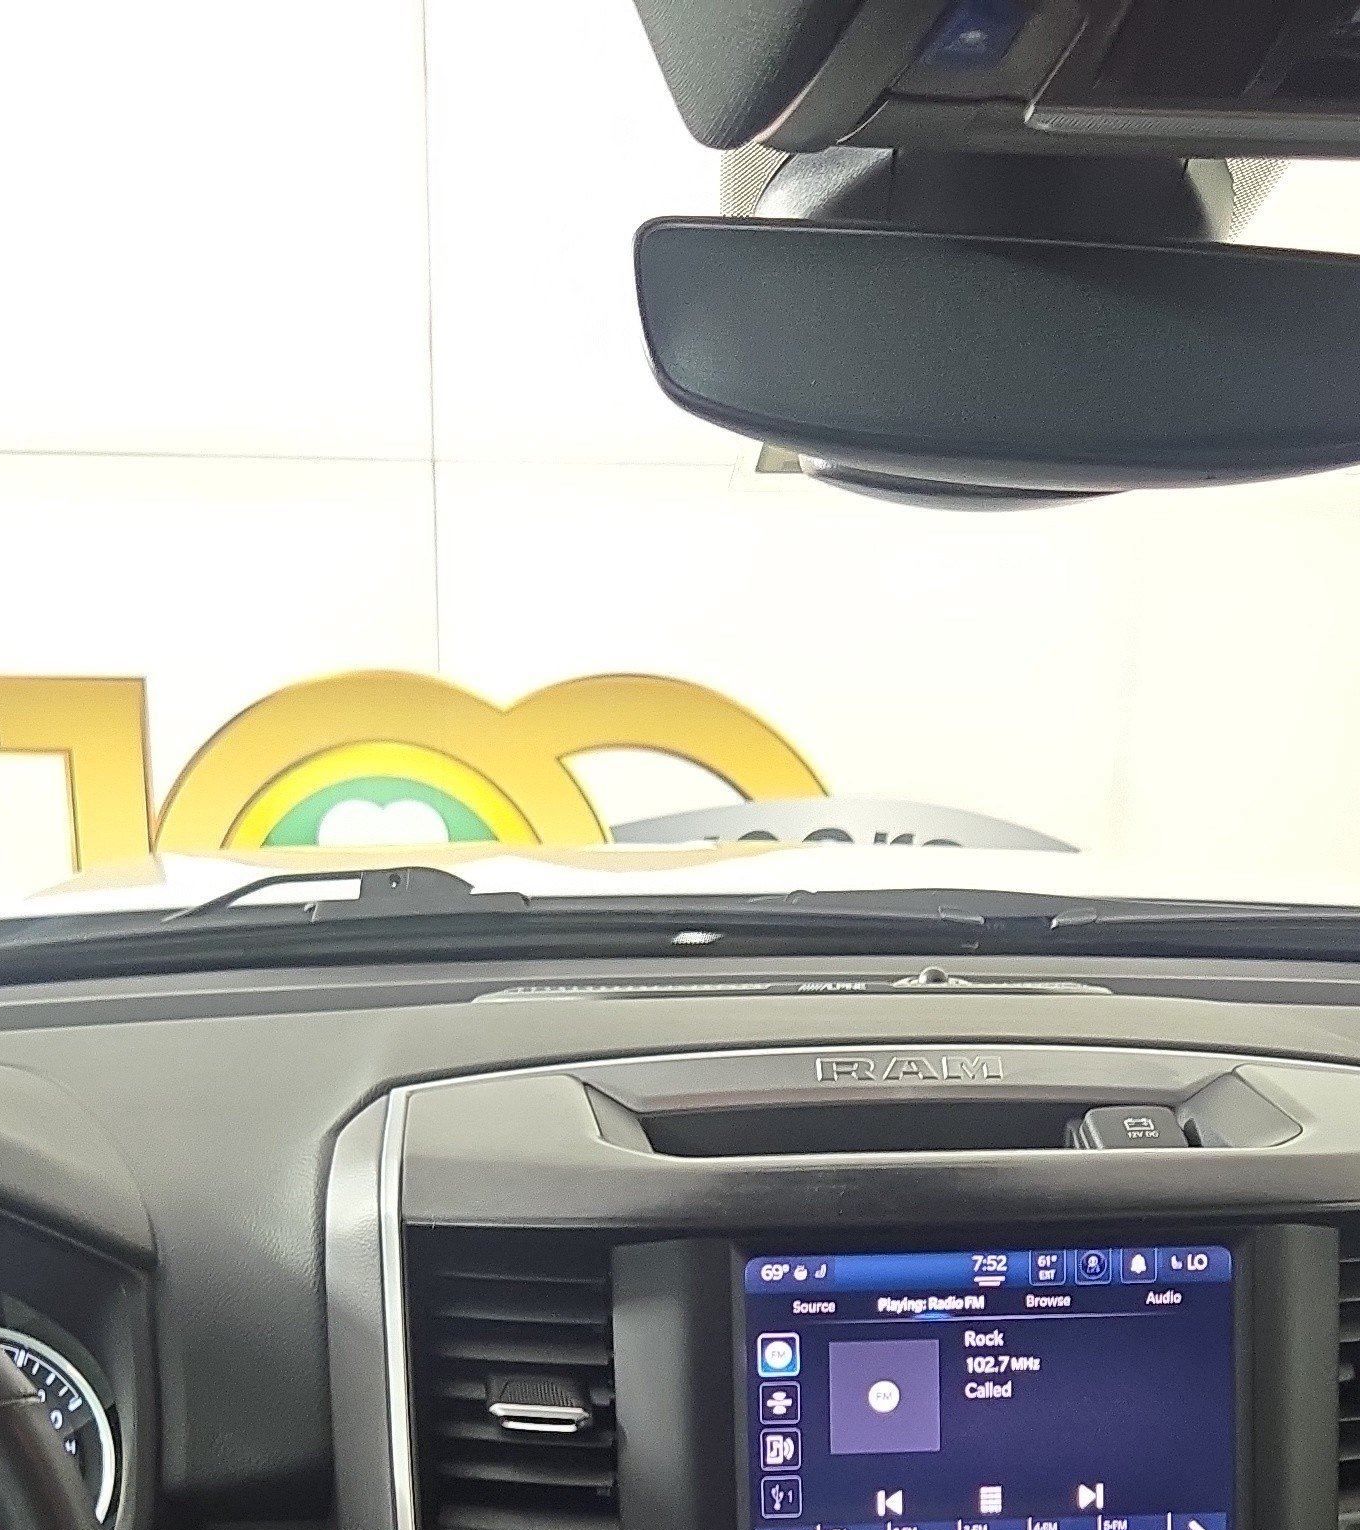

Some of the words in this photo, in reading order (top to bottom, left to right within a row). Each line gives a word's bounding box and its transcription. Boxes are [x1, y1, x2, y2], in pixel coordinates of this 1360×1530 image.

[815, 1055, 1003, 1082] RAM
[1127, 1130, 1144, 1139] 12V
[972, 1255, 1007, 1271] 7:52
[1187, 1253, 1208, 1270] LO
[878, 1297, 926, 1313] Playing:
[928, 1296, 963, 1310] Radio
[964, 1295, 985, 1310] FM
[1026, 1294, 1071, 1308] Browse
[1146, 1290, 1182, 1305] Audio
[793, 1299, 836, 1314] Source
[964, 1329, 1004, 1347] Rock
[771, 1351, 786, 1359] FM
[966, 1356, 1010, 1373] 102.7
[1010, 1356, 1040, 1371] MHz
[875, 1391, 893, 1401] FM
[965, 1381, 1012, 1399] Called
